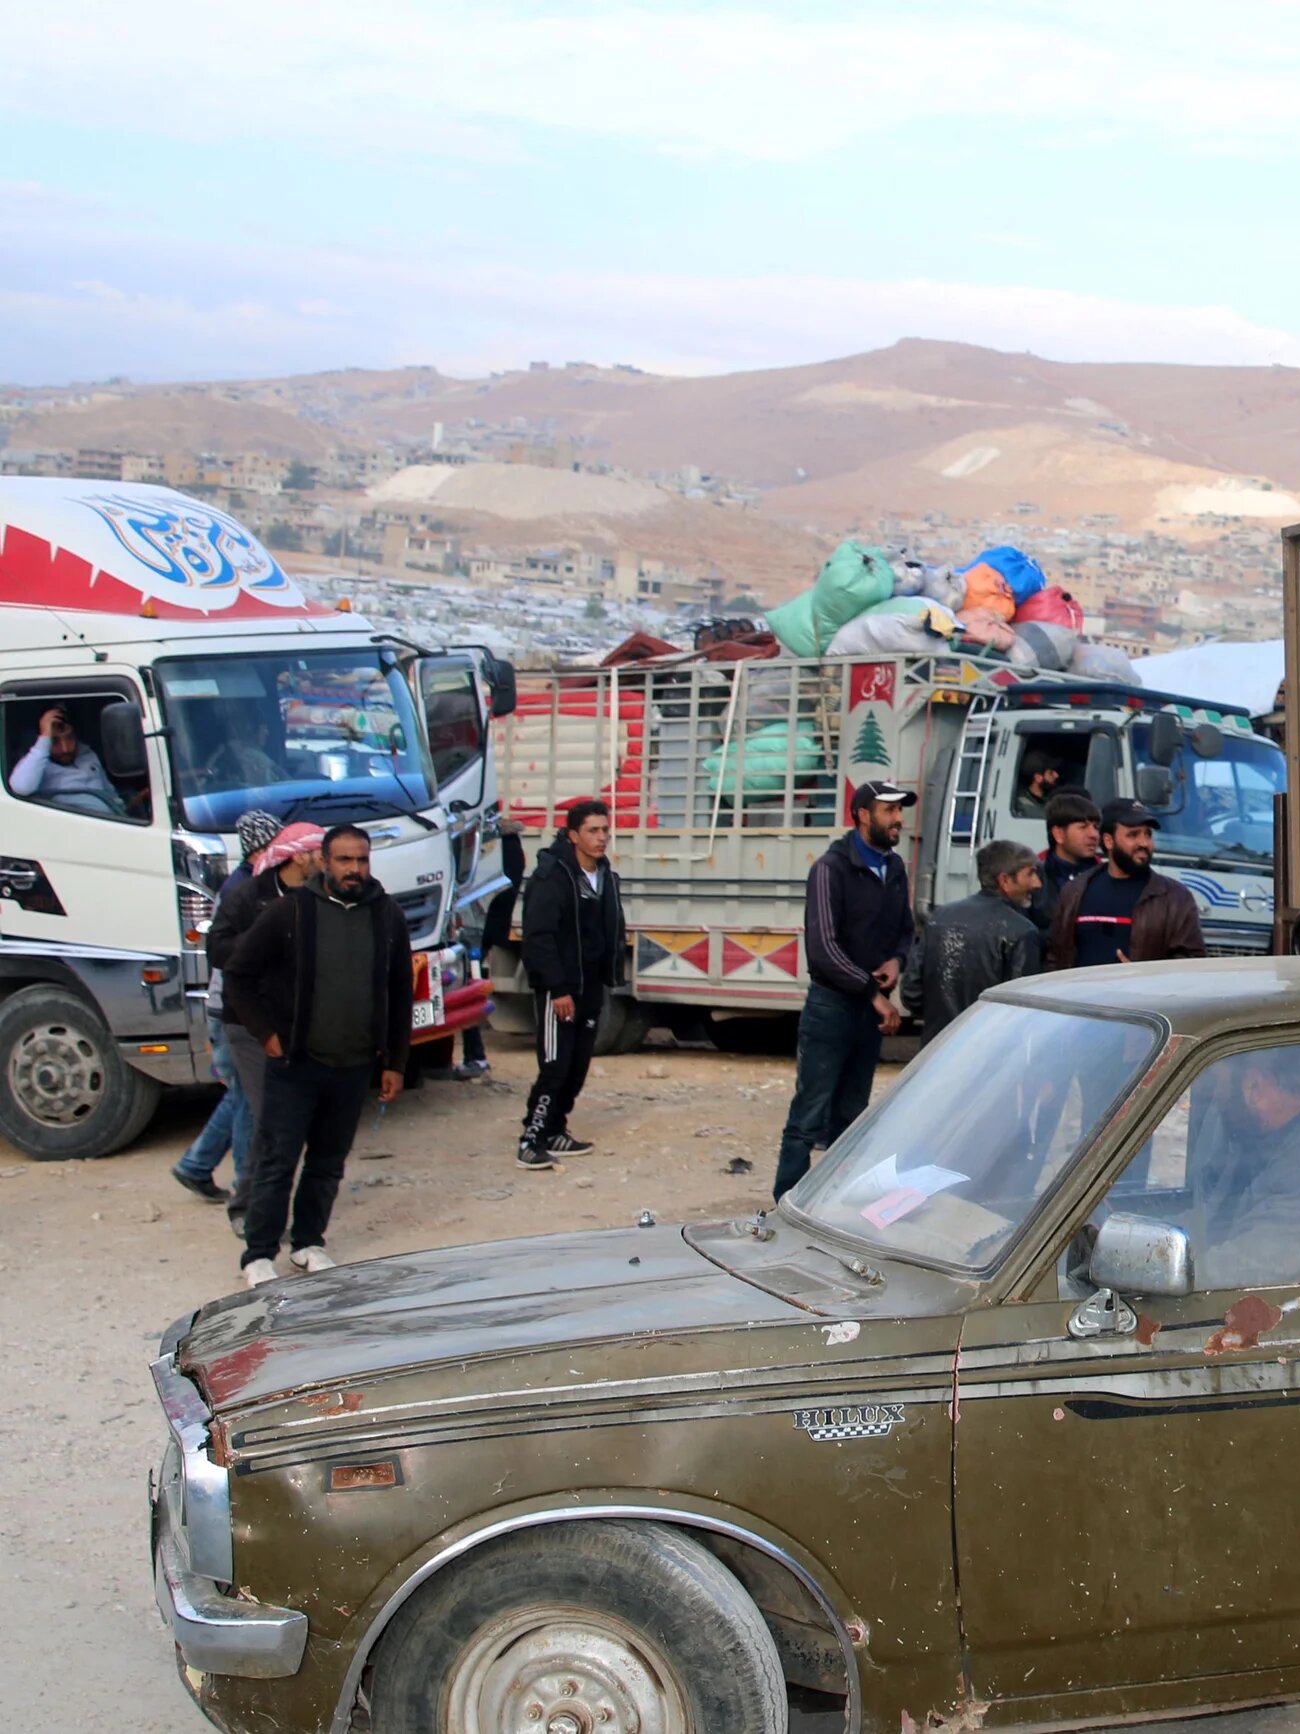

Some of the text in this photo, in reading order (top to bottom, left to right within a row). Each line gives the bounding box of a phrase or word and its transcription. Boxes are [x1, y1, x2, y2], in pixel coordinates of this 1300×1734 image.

[983, 728, 1011, 840] HIN
[416, 870, 443, 885] 500
[793, 1405, 905, 1429] HILUX
